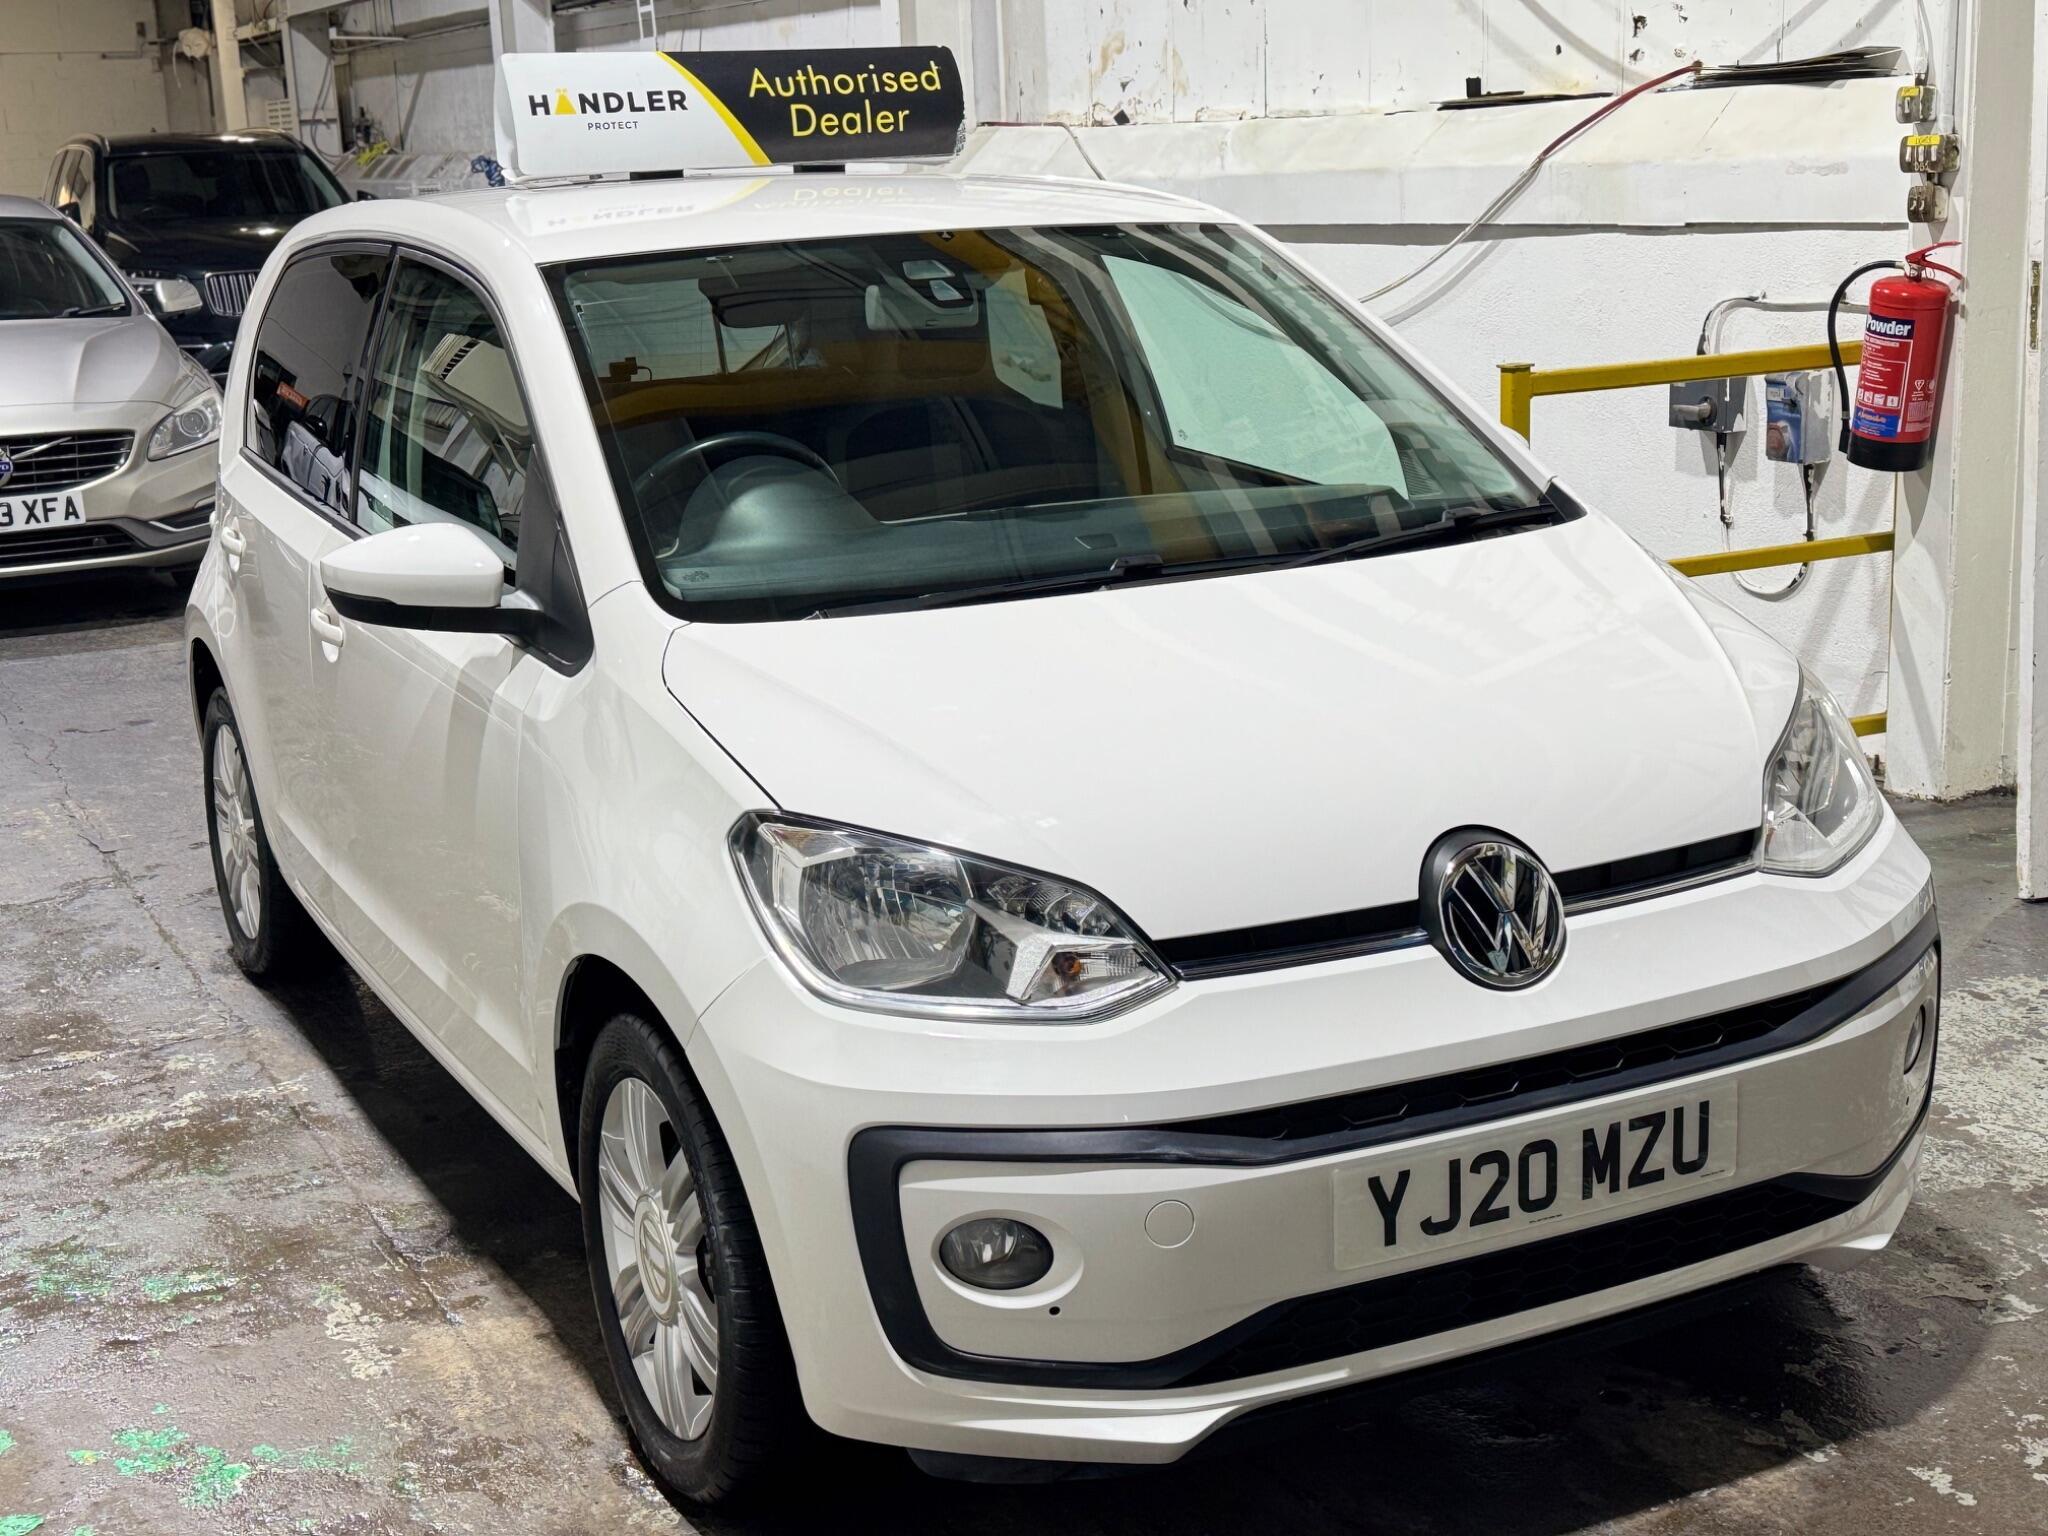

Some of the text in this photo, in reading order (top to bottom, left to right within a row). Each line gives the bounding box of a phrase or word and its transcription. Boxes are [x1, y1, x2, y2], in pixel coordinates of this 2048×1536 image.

[749, 60, 942, 98] Authorised
[587, 121, 638, 131] PROTECT
[790, 99, 910, 137] Dealer
[1866, 314, 1912, 336] Powder
[21, 495, 80, 525] XFA
[1367, 1100, 1710, 1247] YJ20 MZU
